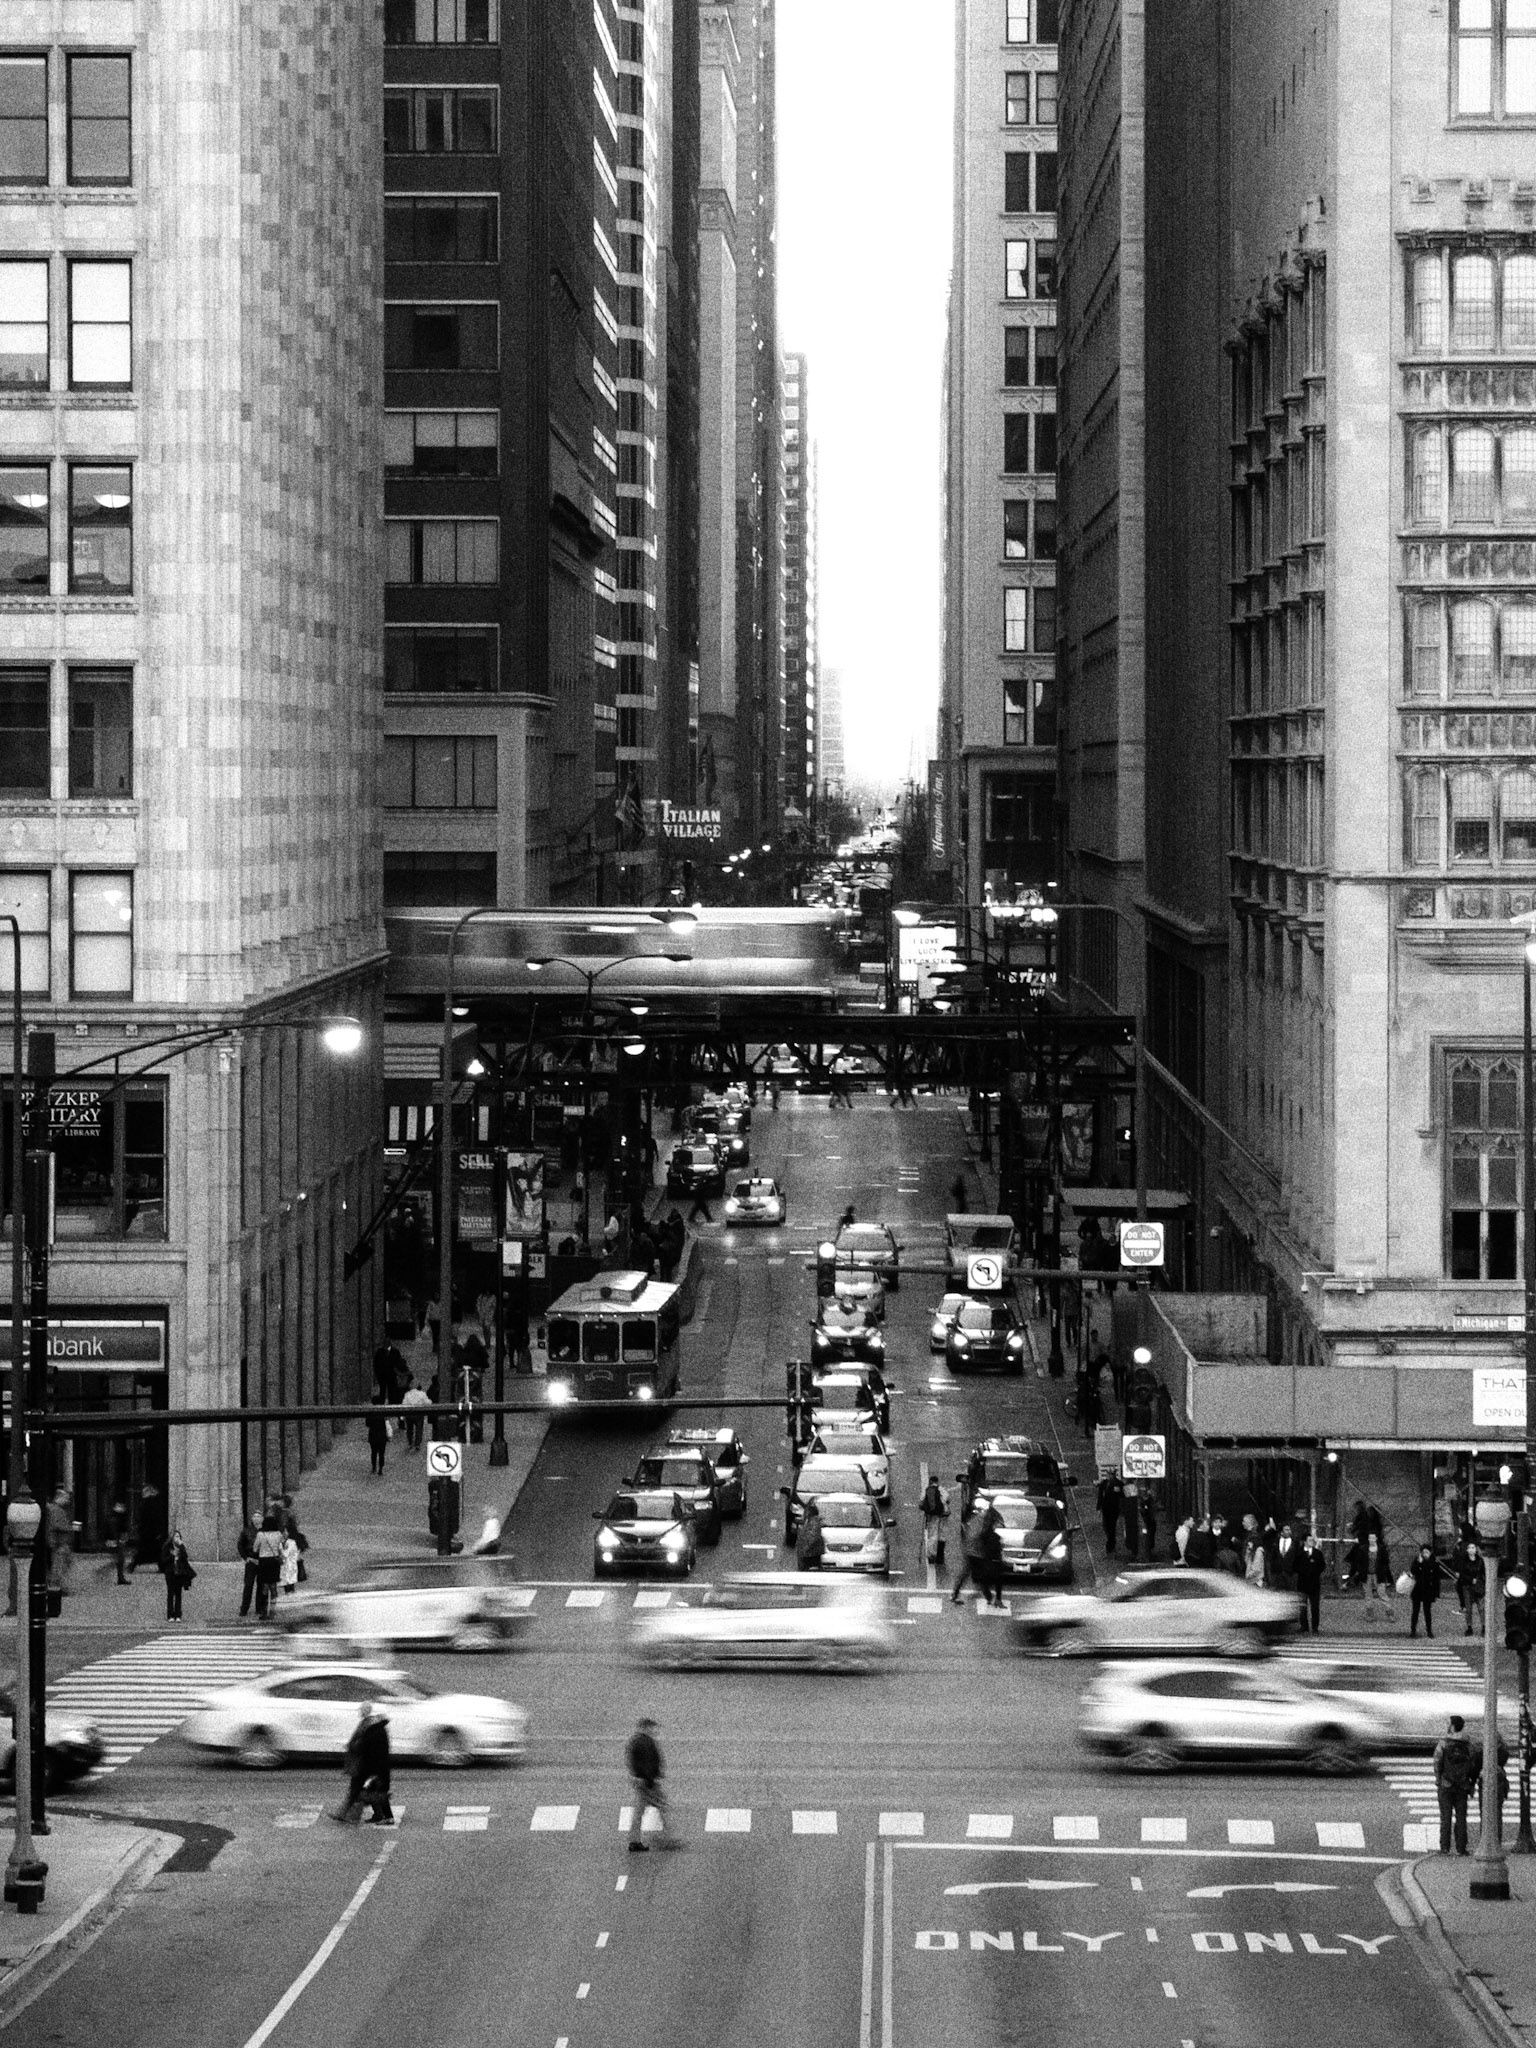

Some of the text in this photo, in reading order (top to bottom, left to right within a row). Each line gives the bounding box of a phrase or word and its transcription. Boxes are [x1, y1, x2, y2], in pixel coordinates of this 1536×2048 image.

[660, 799, 721, 823] ITALIAN
[662, 824, 722, 838] VILLAGE
[64, 1129, 100, 1137] LIBRARY
[1127, 1231, 1157, 1239] DO NOT
[1130, 1249, 1154, 1257] ENTER
[1461, 1317, 1499, 1331] Michigan
[1483, 1407, 1512, 1418] OPEN
[1128, 1443, 1159, 1452] DO NOT
[914, 1930, 1398, 1955] ONLY ONLY
